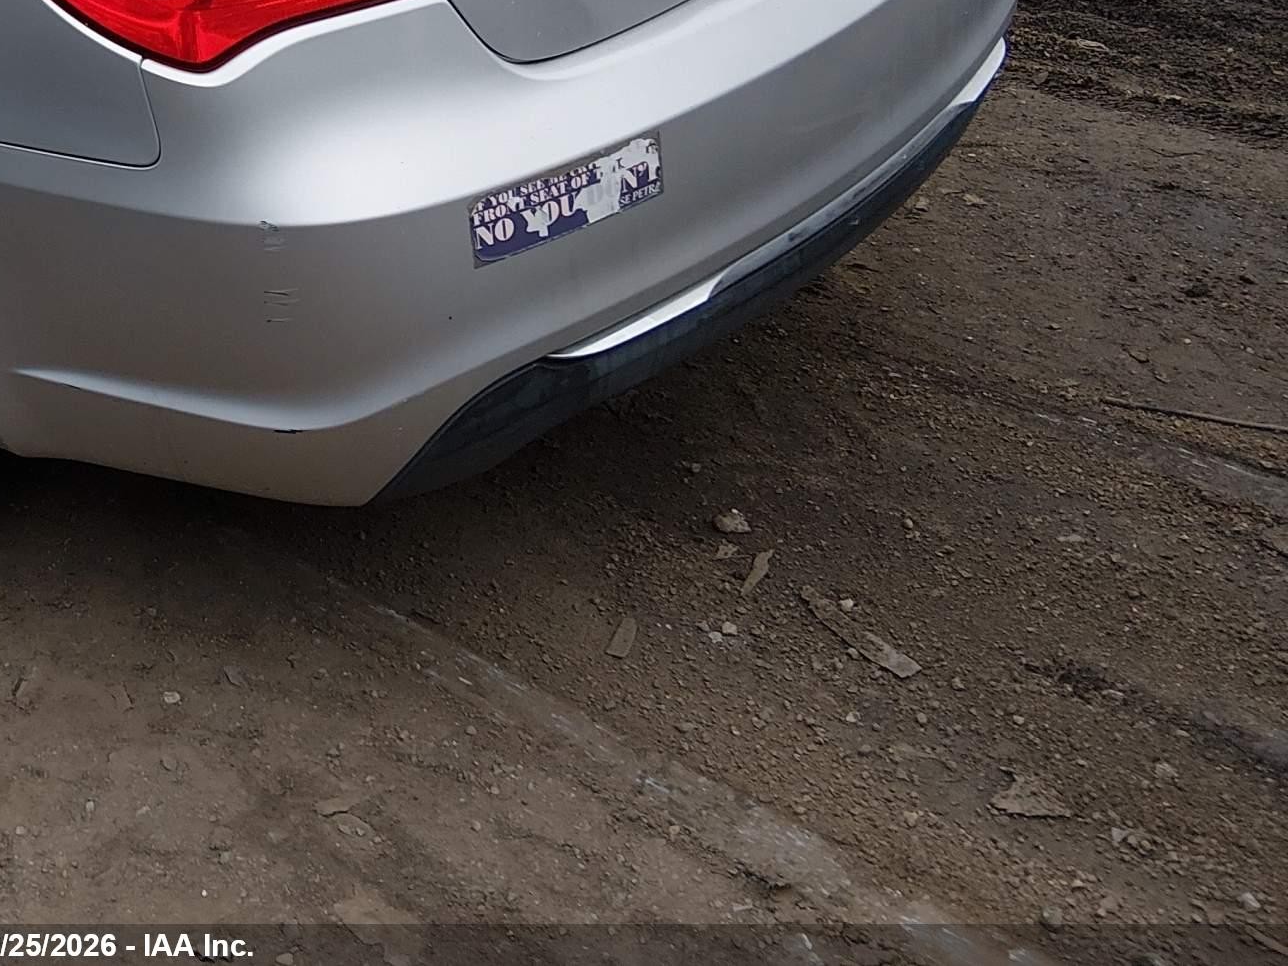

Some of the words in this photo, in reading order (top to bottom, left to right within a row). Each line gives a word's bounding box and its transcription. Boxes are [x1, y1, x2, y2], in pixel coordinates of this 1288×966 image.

[529, 182, 569, 207] SEAT
[571, 171, 593, 189] OF
[474, 217, 515, 251] NO
